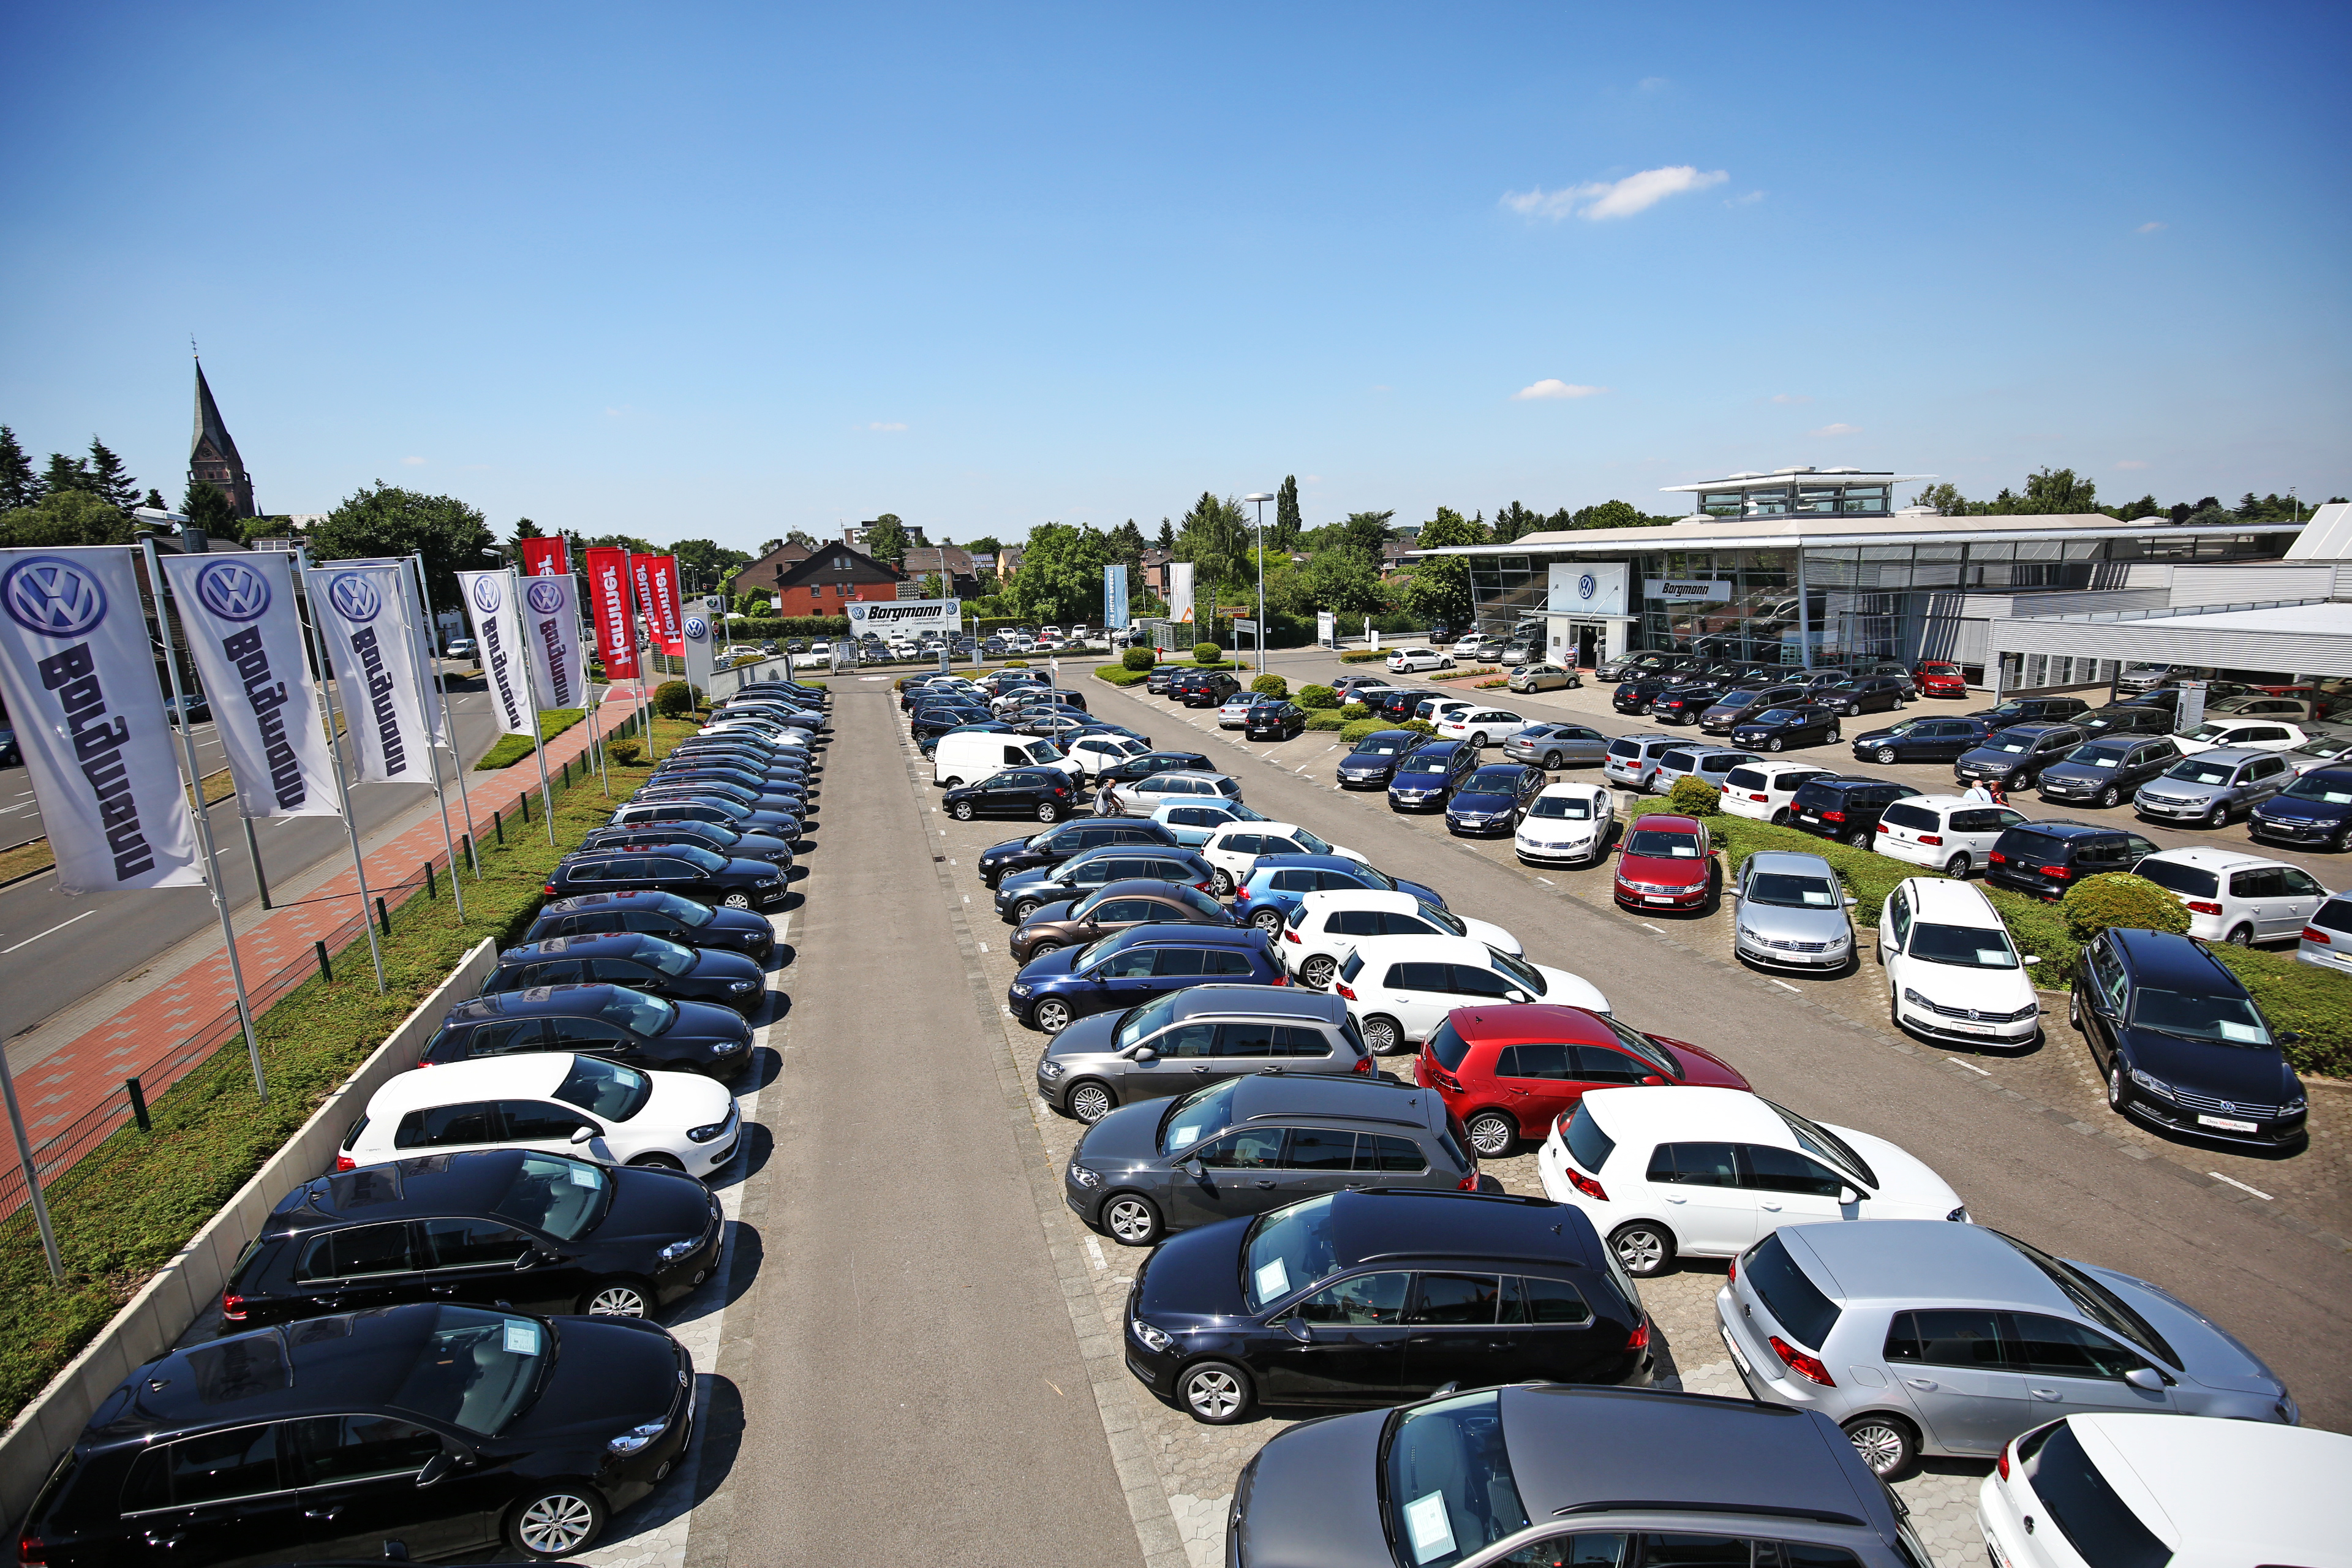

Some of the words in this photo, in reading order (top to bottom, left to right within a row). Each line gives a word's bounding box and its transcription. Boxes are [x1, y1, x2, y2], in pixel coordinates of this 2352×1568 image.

[1662, 582, 1709, 597] Borgmann
[868, 606, 942, 622] Borgmann
[2175, 702, 2184, 731] Borgmann
